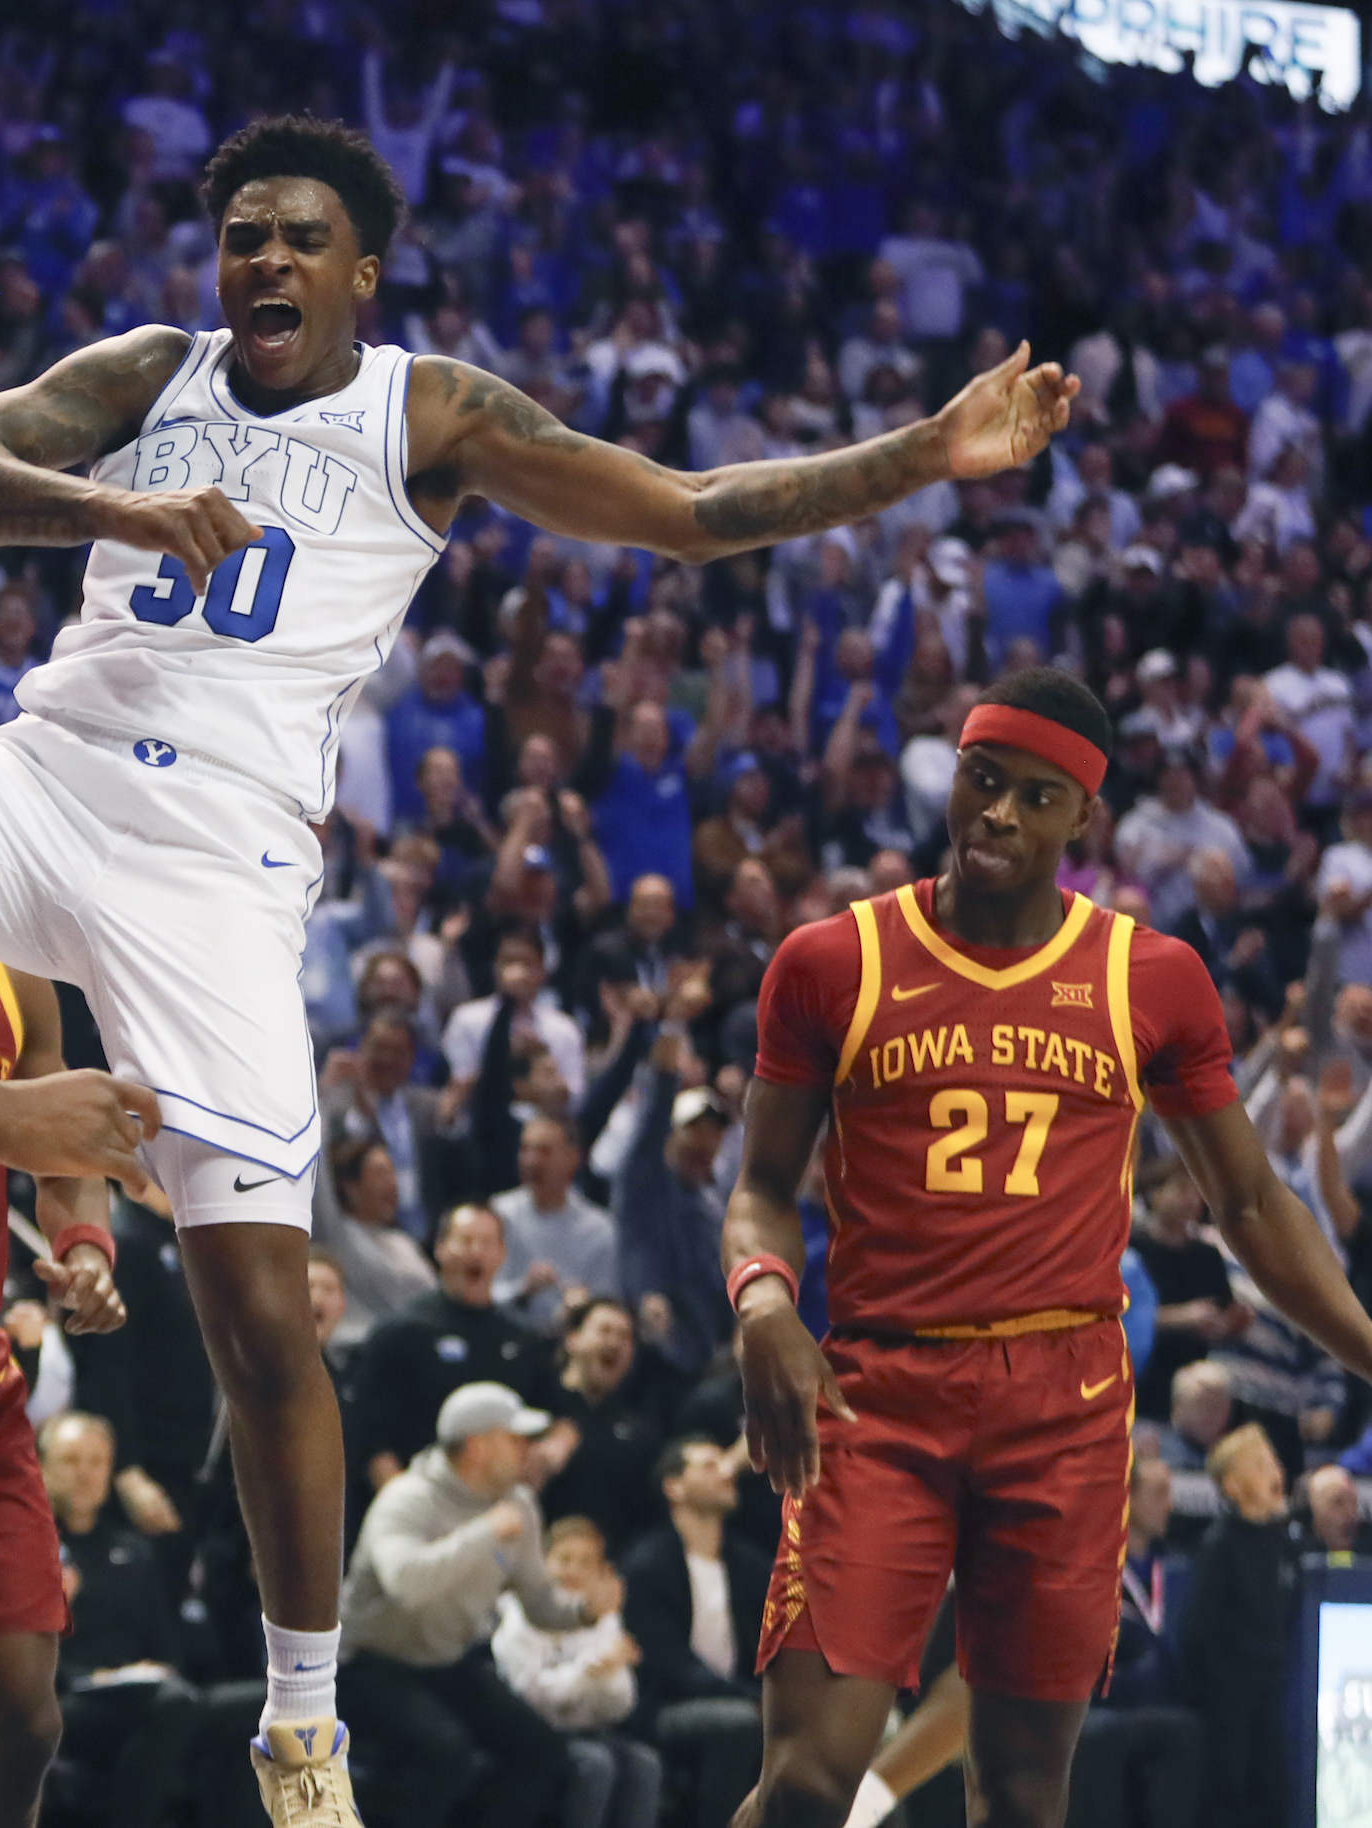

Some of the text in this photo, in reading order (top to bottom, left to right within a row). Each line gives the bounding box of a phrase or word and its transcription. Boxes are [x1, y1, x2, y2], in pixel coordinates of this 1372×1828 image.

[132, 422, 357, 535] BYU
[870, 1024, 1116, 1099] IOWA STATE
[926, 1089, 1060, 1197] 27
